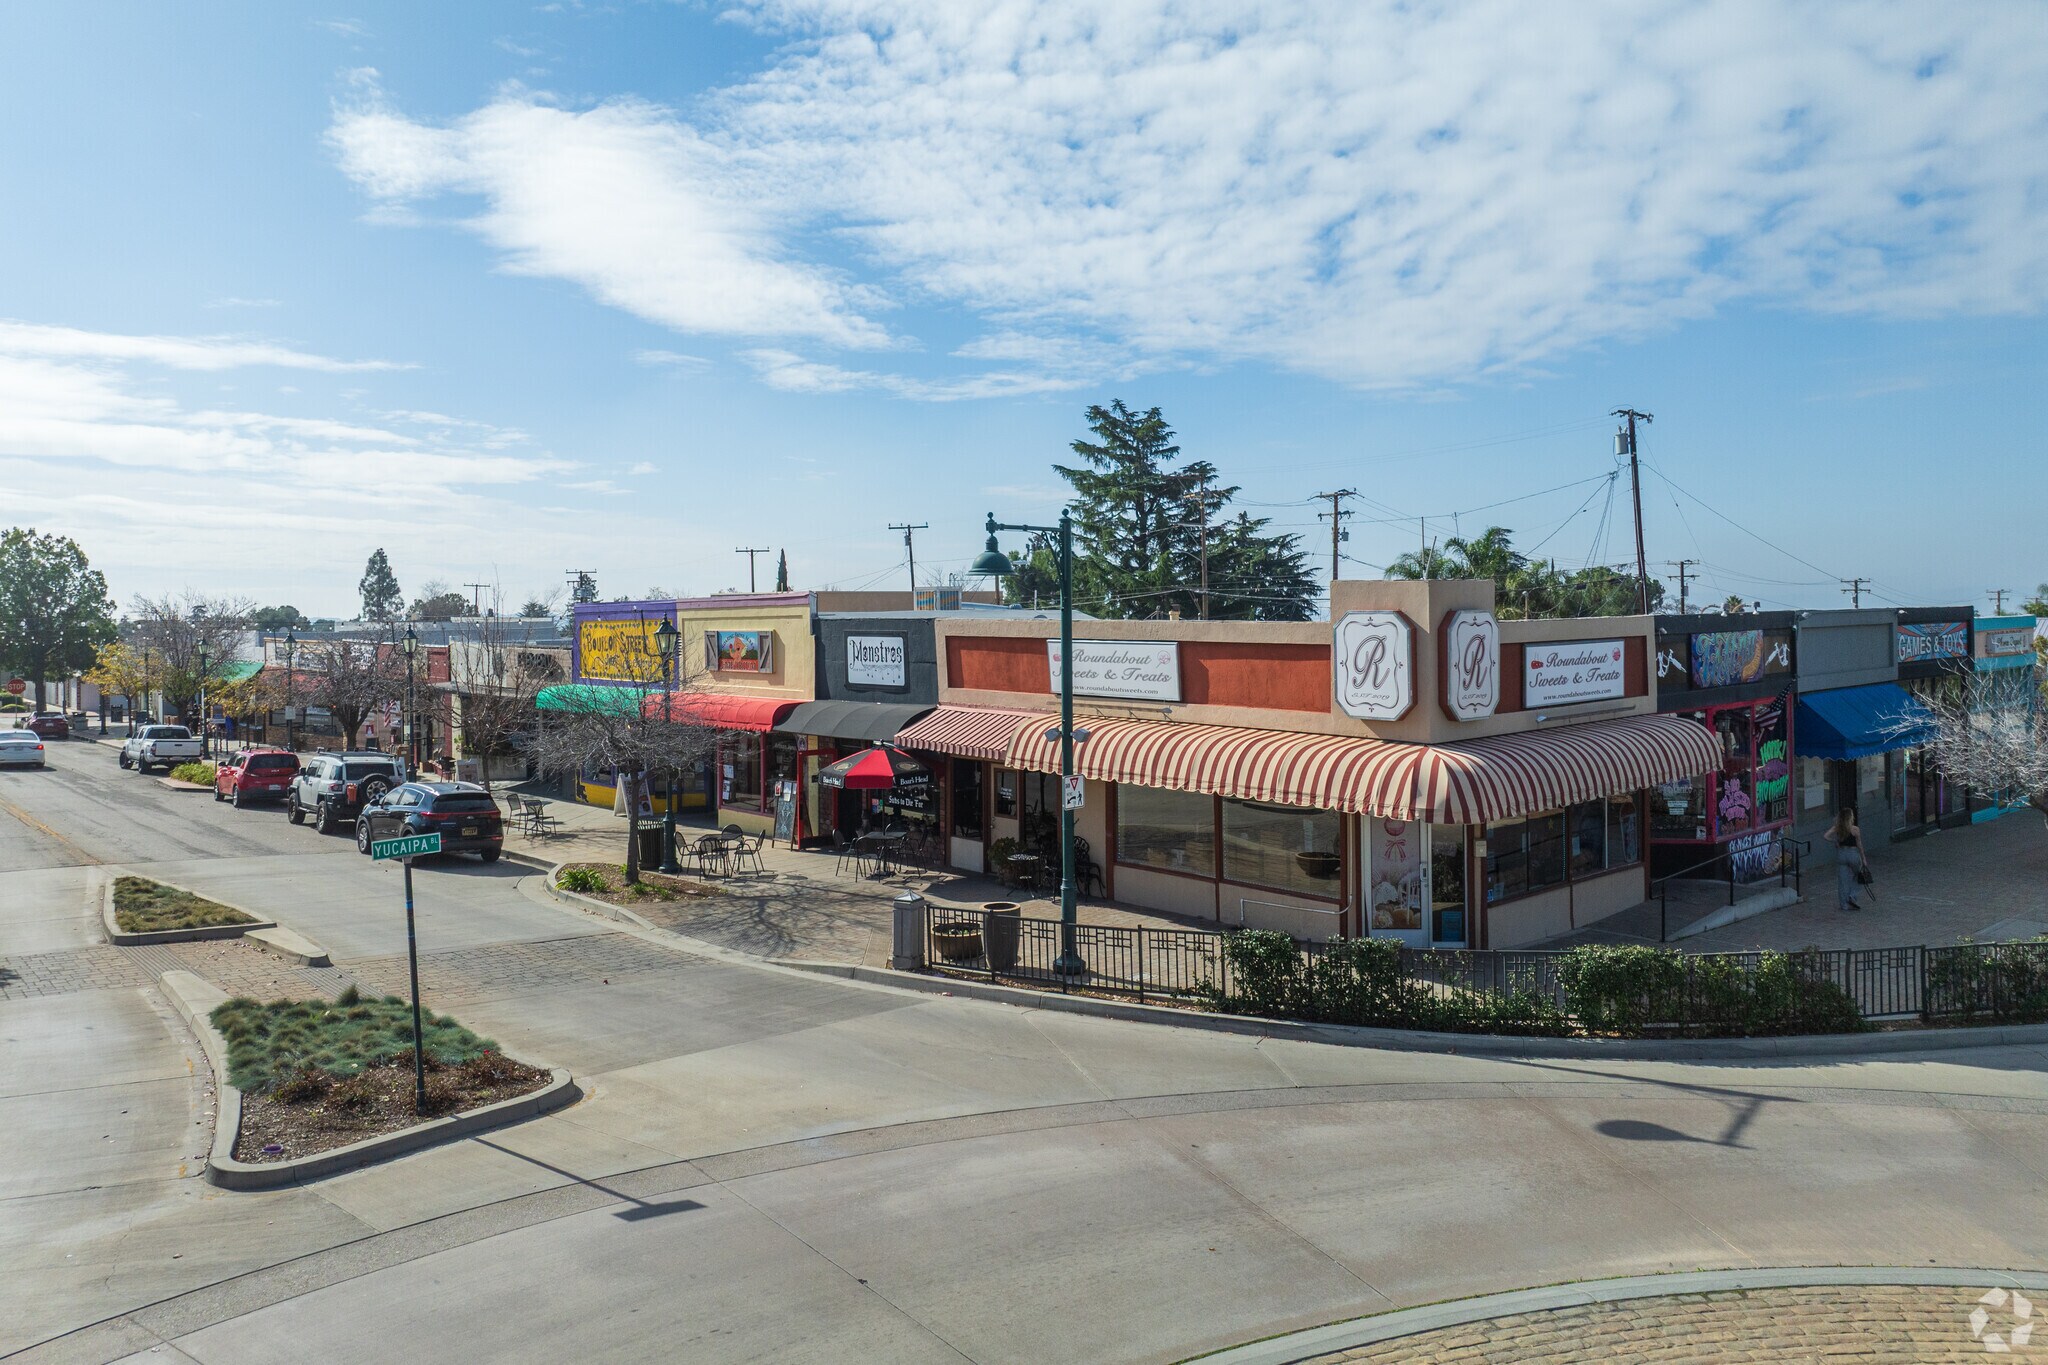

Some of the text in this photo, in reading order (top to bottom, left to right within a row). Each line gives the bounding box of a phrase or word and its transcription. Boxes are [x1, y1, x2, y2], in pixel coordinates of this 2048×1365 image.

[1898, 630, 1964, 661] GAMES & TOYS
[1071, 649, 1152, 665] Roundabout
[1546, 650, 1609, 668] Roundabout
[1052, 665, 1172, 683] Seets & Treats
[1529, 667, 1621, 688] Sweets & Treats
[9, 683, 25, 691] STOP
[1073, 685, 1159, 695] ww.roundaboutsweets.com
[1543, 688, 1612, 701] www.roundaboutsweets.com
[900, 775, 929, 786] Boar's Head
[888, 795, 900, 805] Subs
[375, 839, 428, 857] YUCAIPA
